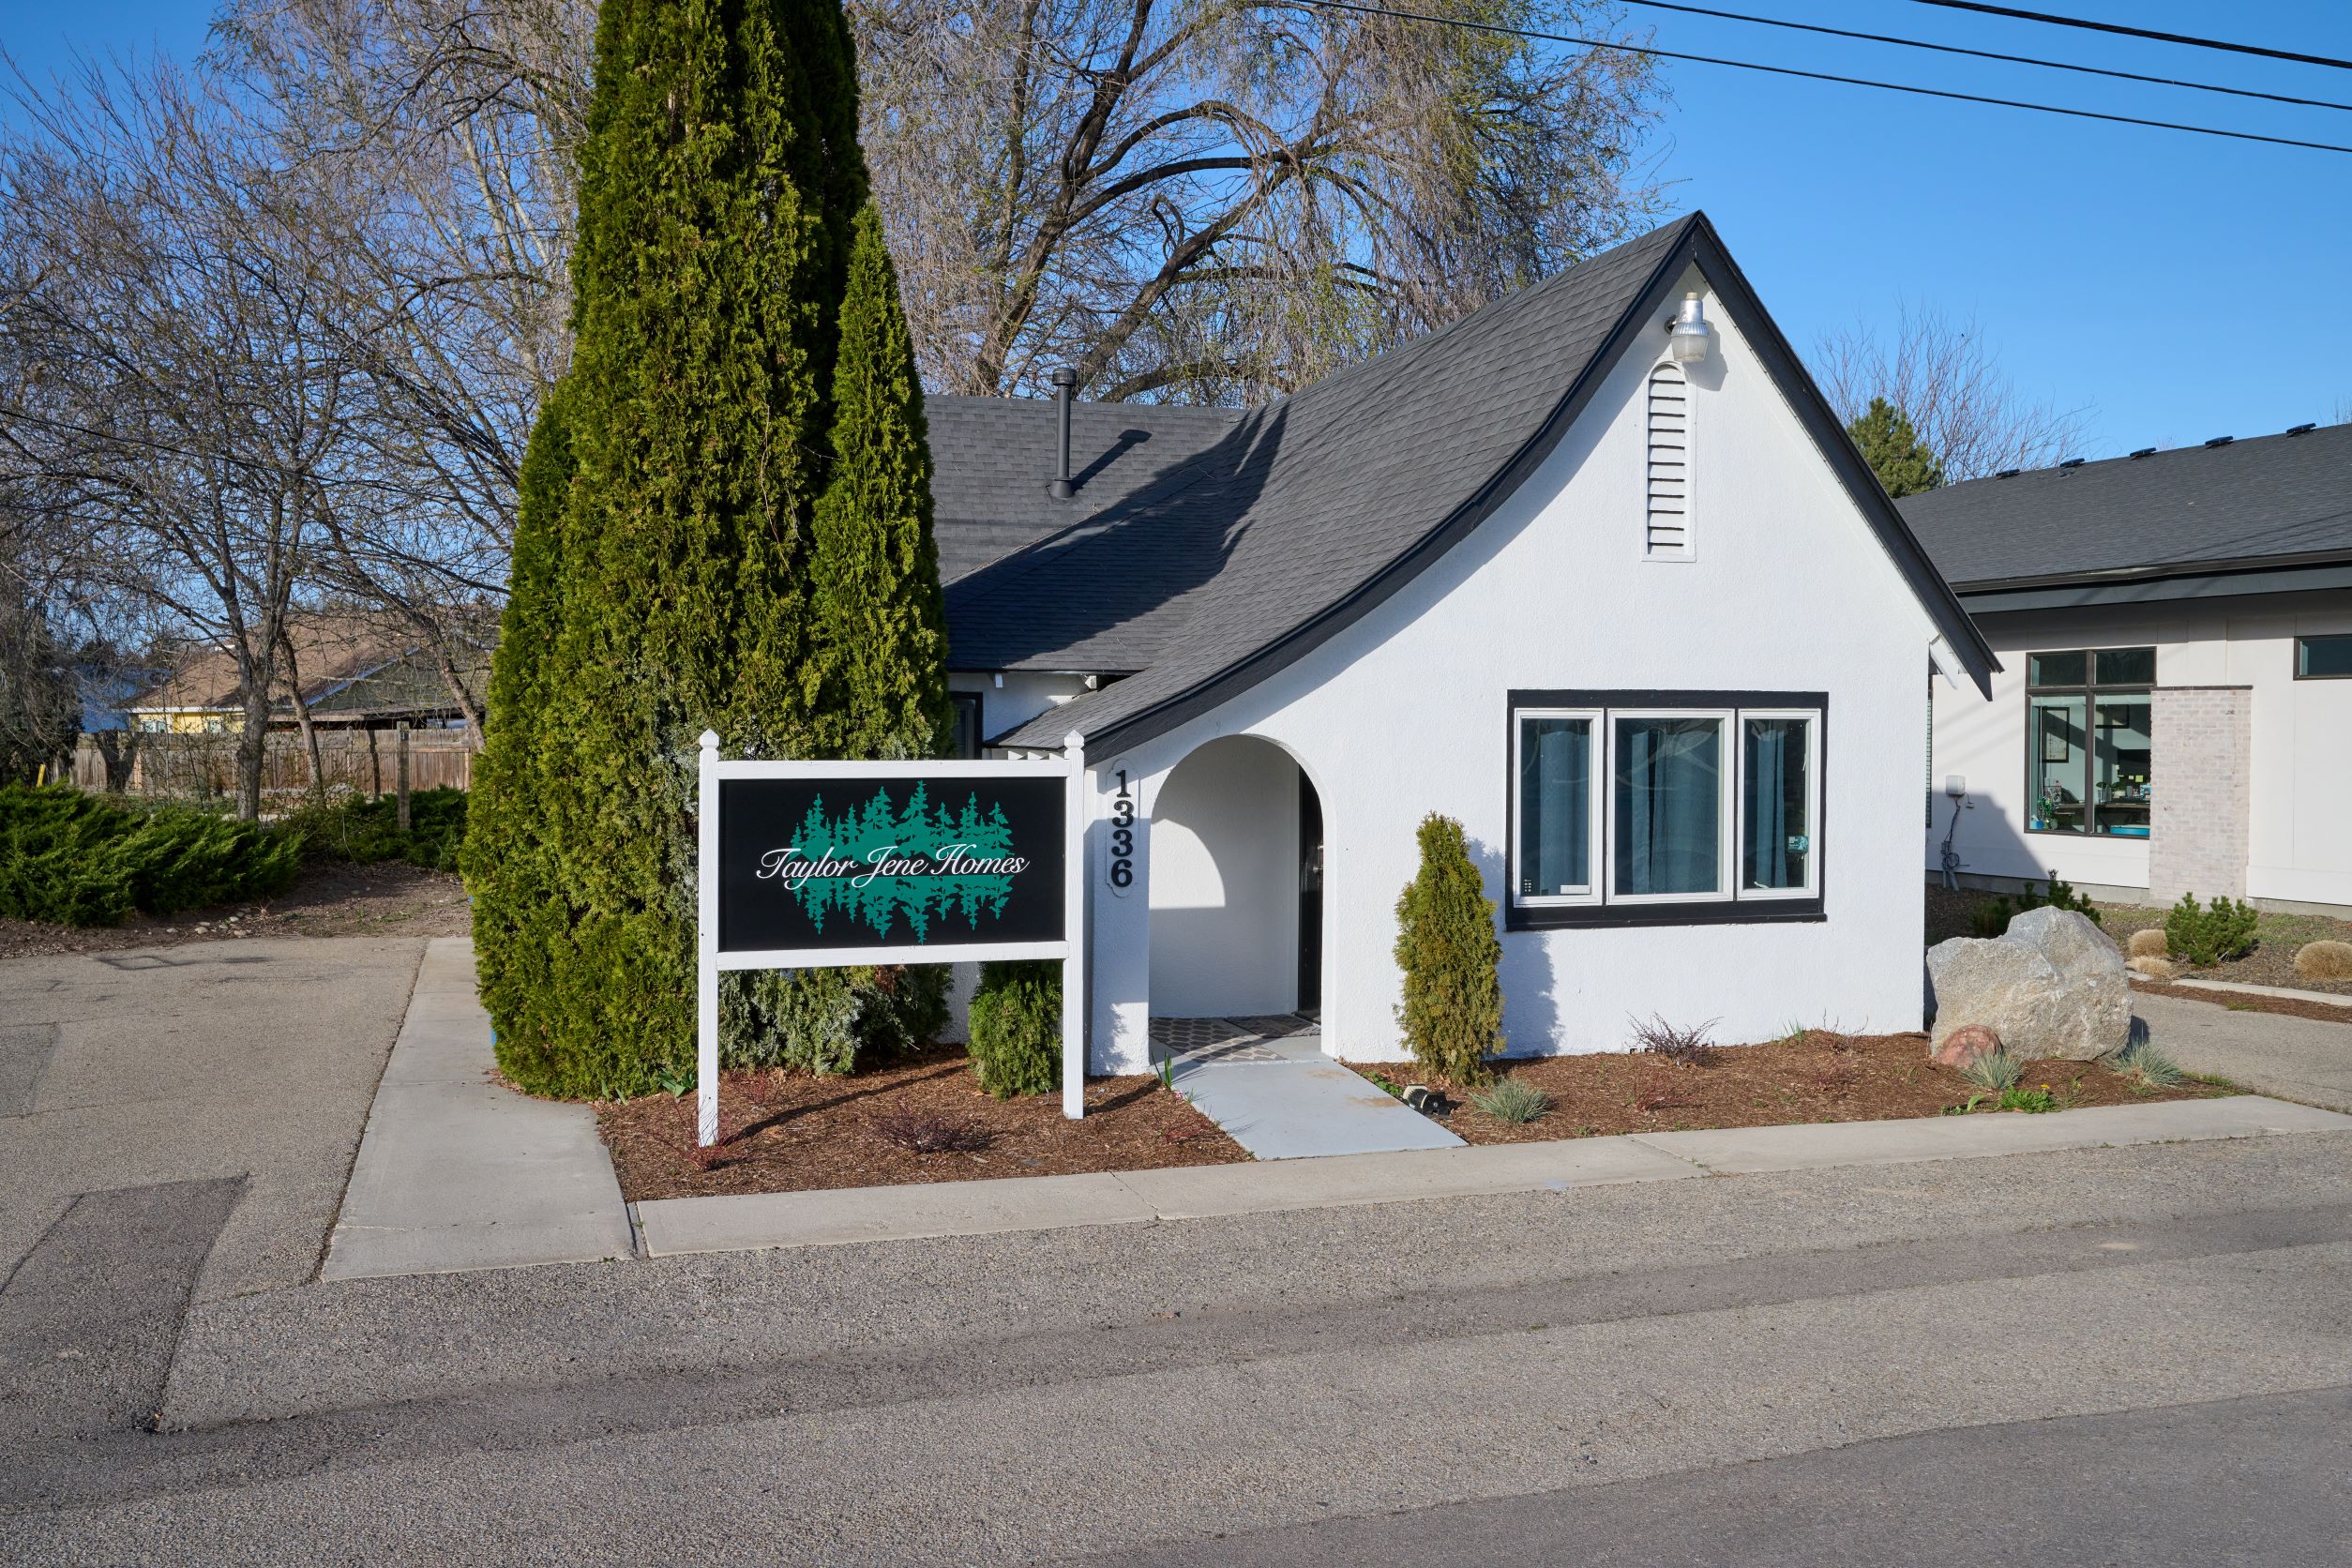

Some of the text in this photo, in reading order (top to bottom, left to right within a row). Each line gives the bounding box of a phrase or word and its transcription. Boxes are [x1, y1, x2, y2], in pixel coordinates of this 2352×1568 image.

[756, 843, 1030, 890] Taylor Jene Homes
[1111, 769, 1134, 888] 1336
